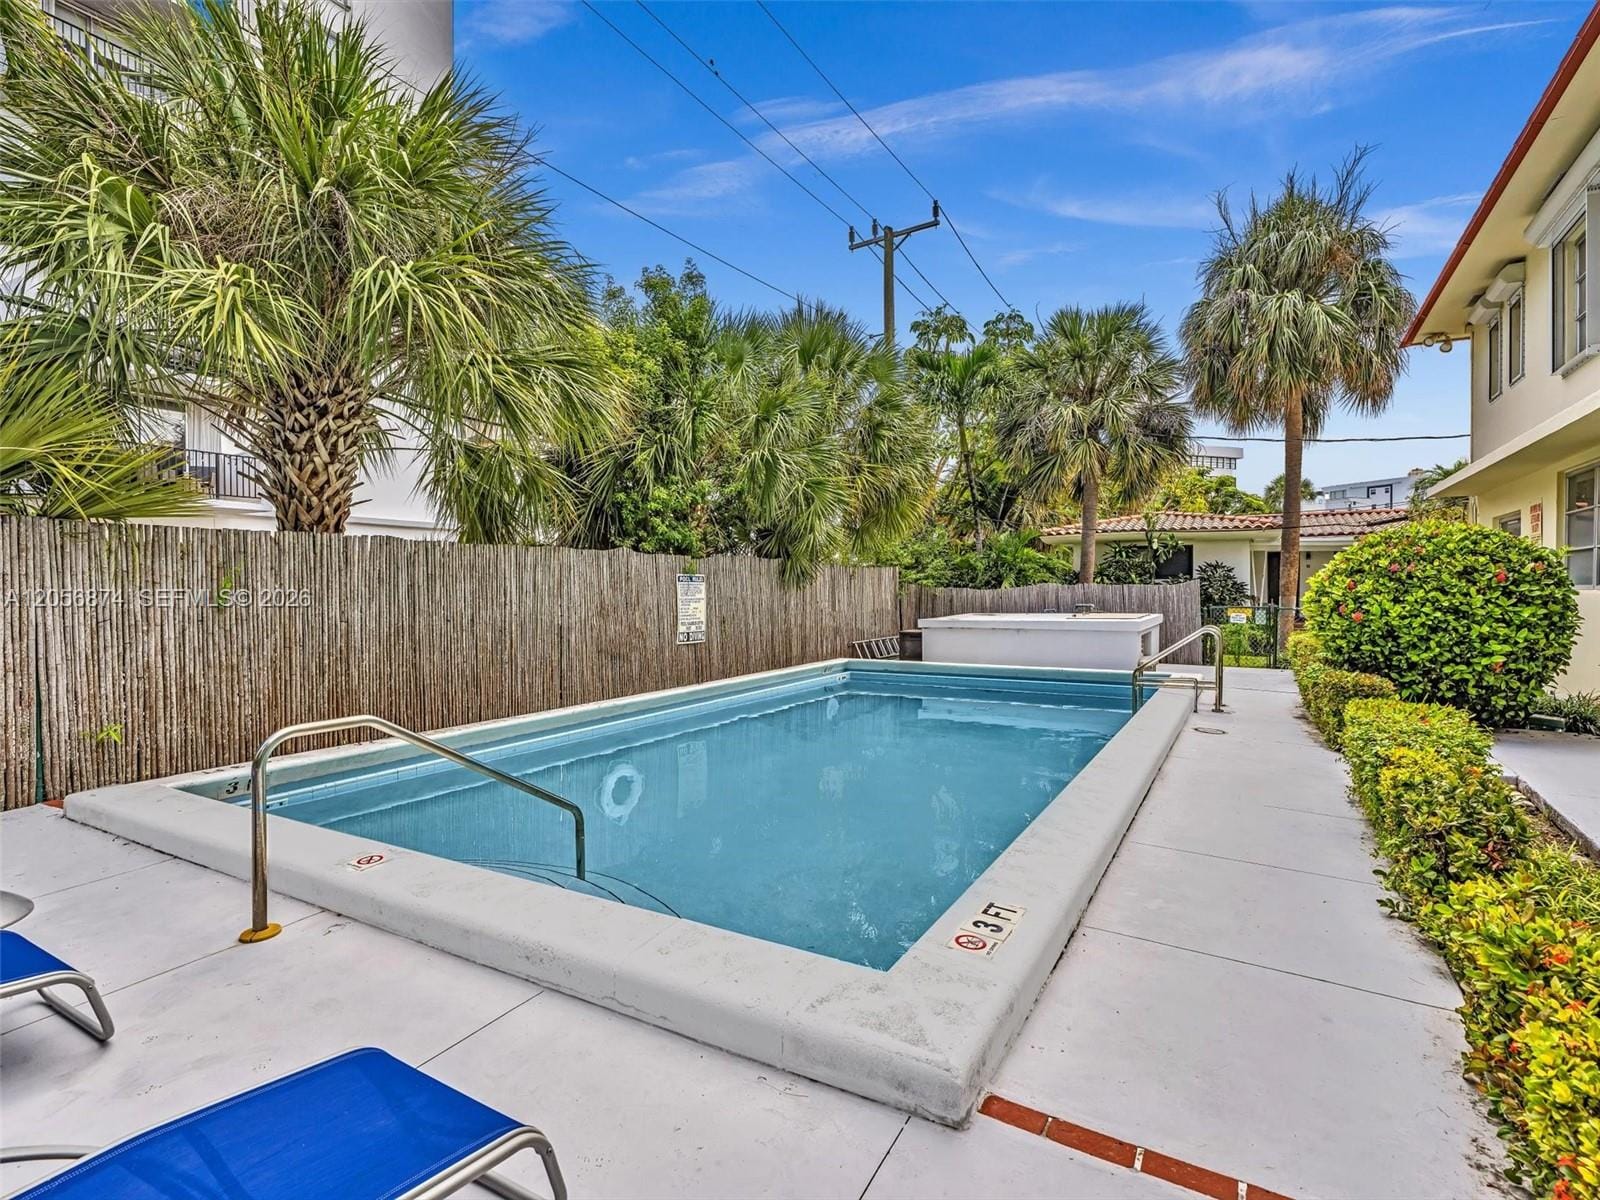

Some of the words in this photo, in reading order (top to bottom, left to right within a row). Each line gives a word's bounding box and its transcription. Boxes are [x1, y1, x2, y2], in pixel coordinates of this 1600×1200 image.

[679, 632, 688, 641] NO
[225, 781, 239, 795] 3
[981, 902, 1017, 921] FT
[972, 920, 1003, 933] 3
